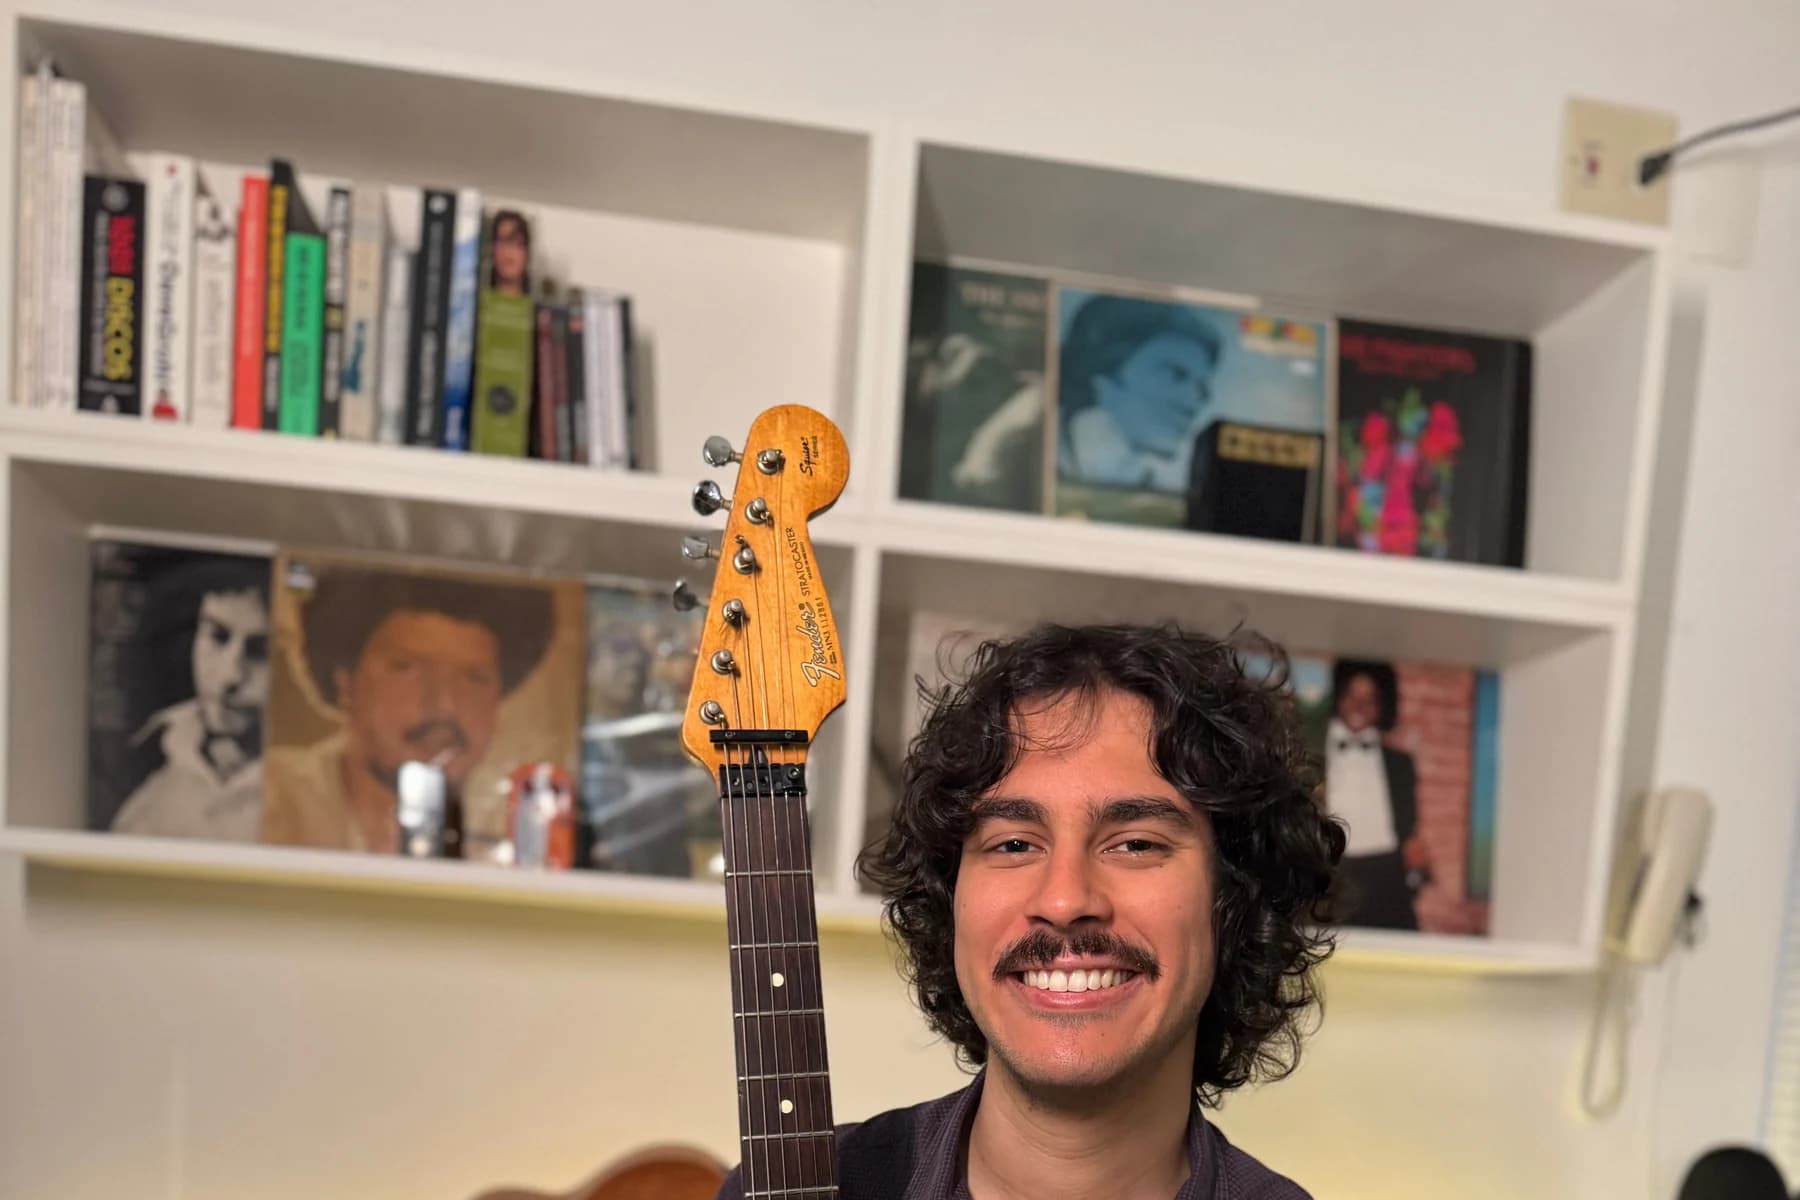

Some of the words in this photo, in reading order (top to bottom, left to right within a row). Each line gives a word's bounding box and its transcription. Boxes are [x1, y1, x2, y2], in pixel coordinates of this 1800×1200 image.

[799, 436, 817, 477] Squier
[785, 527, 811, 597] STRATOCASTER
[795, 601, 841, 688] Fender
